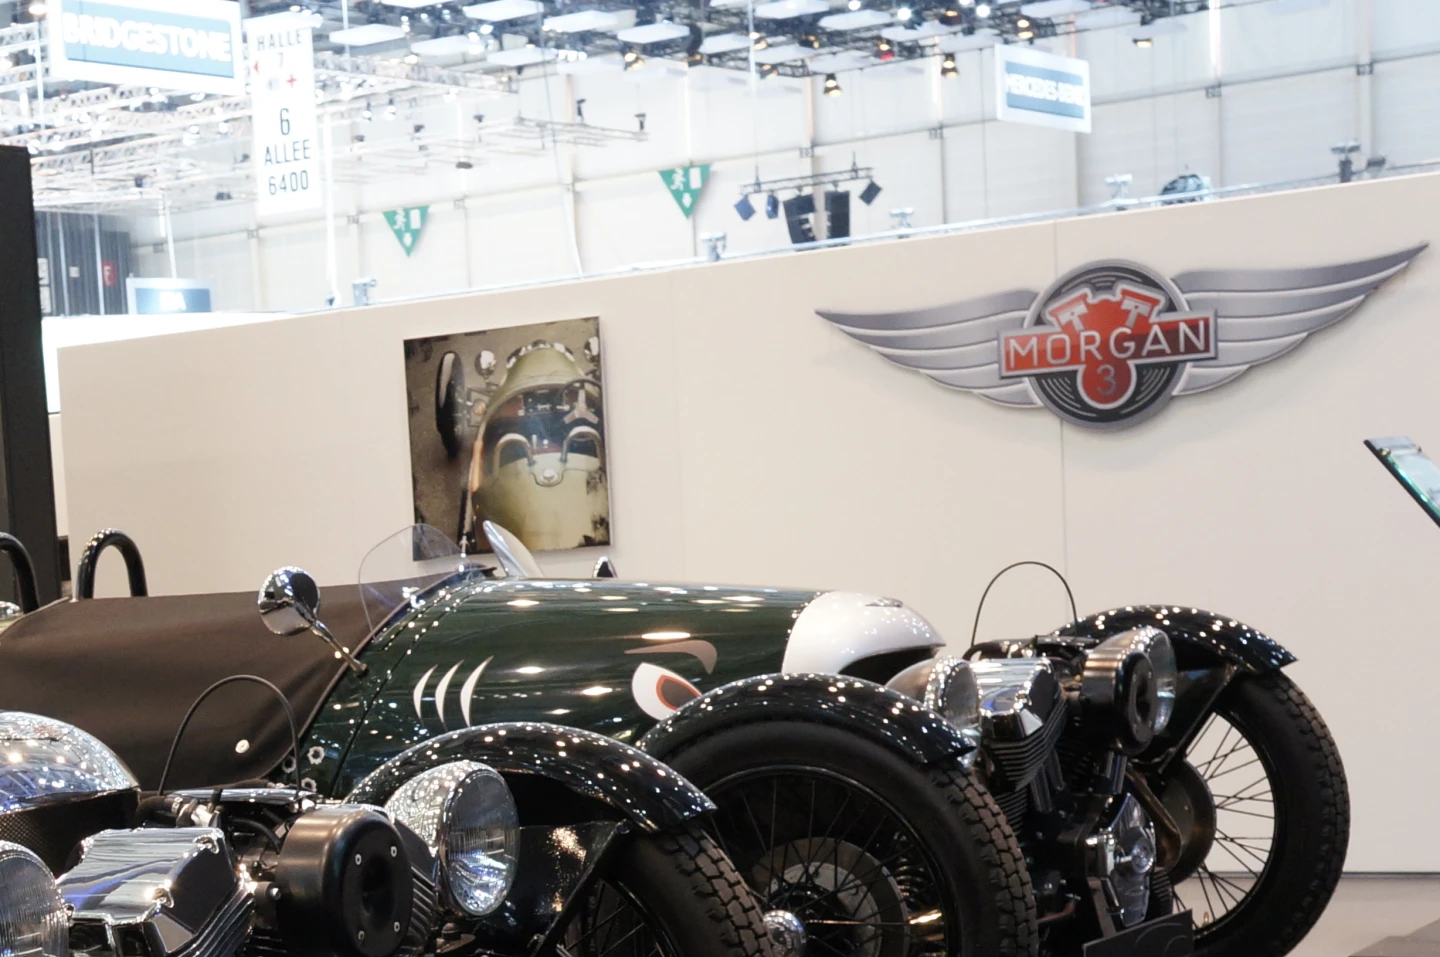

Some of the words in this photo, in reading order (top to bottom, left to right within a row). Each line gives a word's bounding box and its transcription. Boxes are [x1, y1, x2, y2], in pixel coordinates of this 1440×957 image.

[62, 12, 232, 62] BRIDGESTONE
[257, 29, 304, 52] HALLE
[279, 107, 290, 136] 6
[264, 139, 311, 166] ALLEE
[268, 170, 309, 195] 6400
[1009, 319, 1207, 369] MORGAN
[1096, 363, 1117, 396] 3
